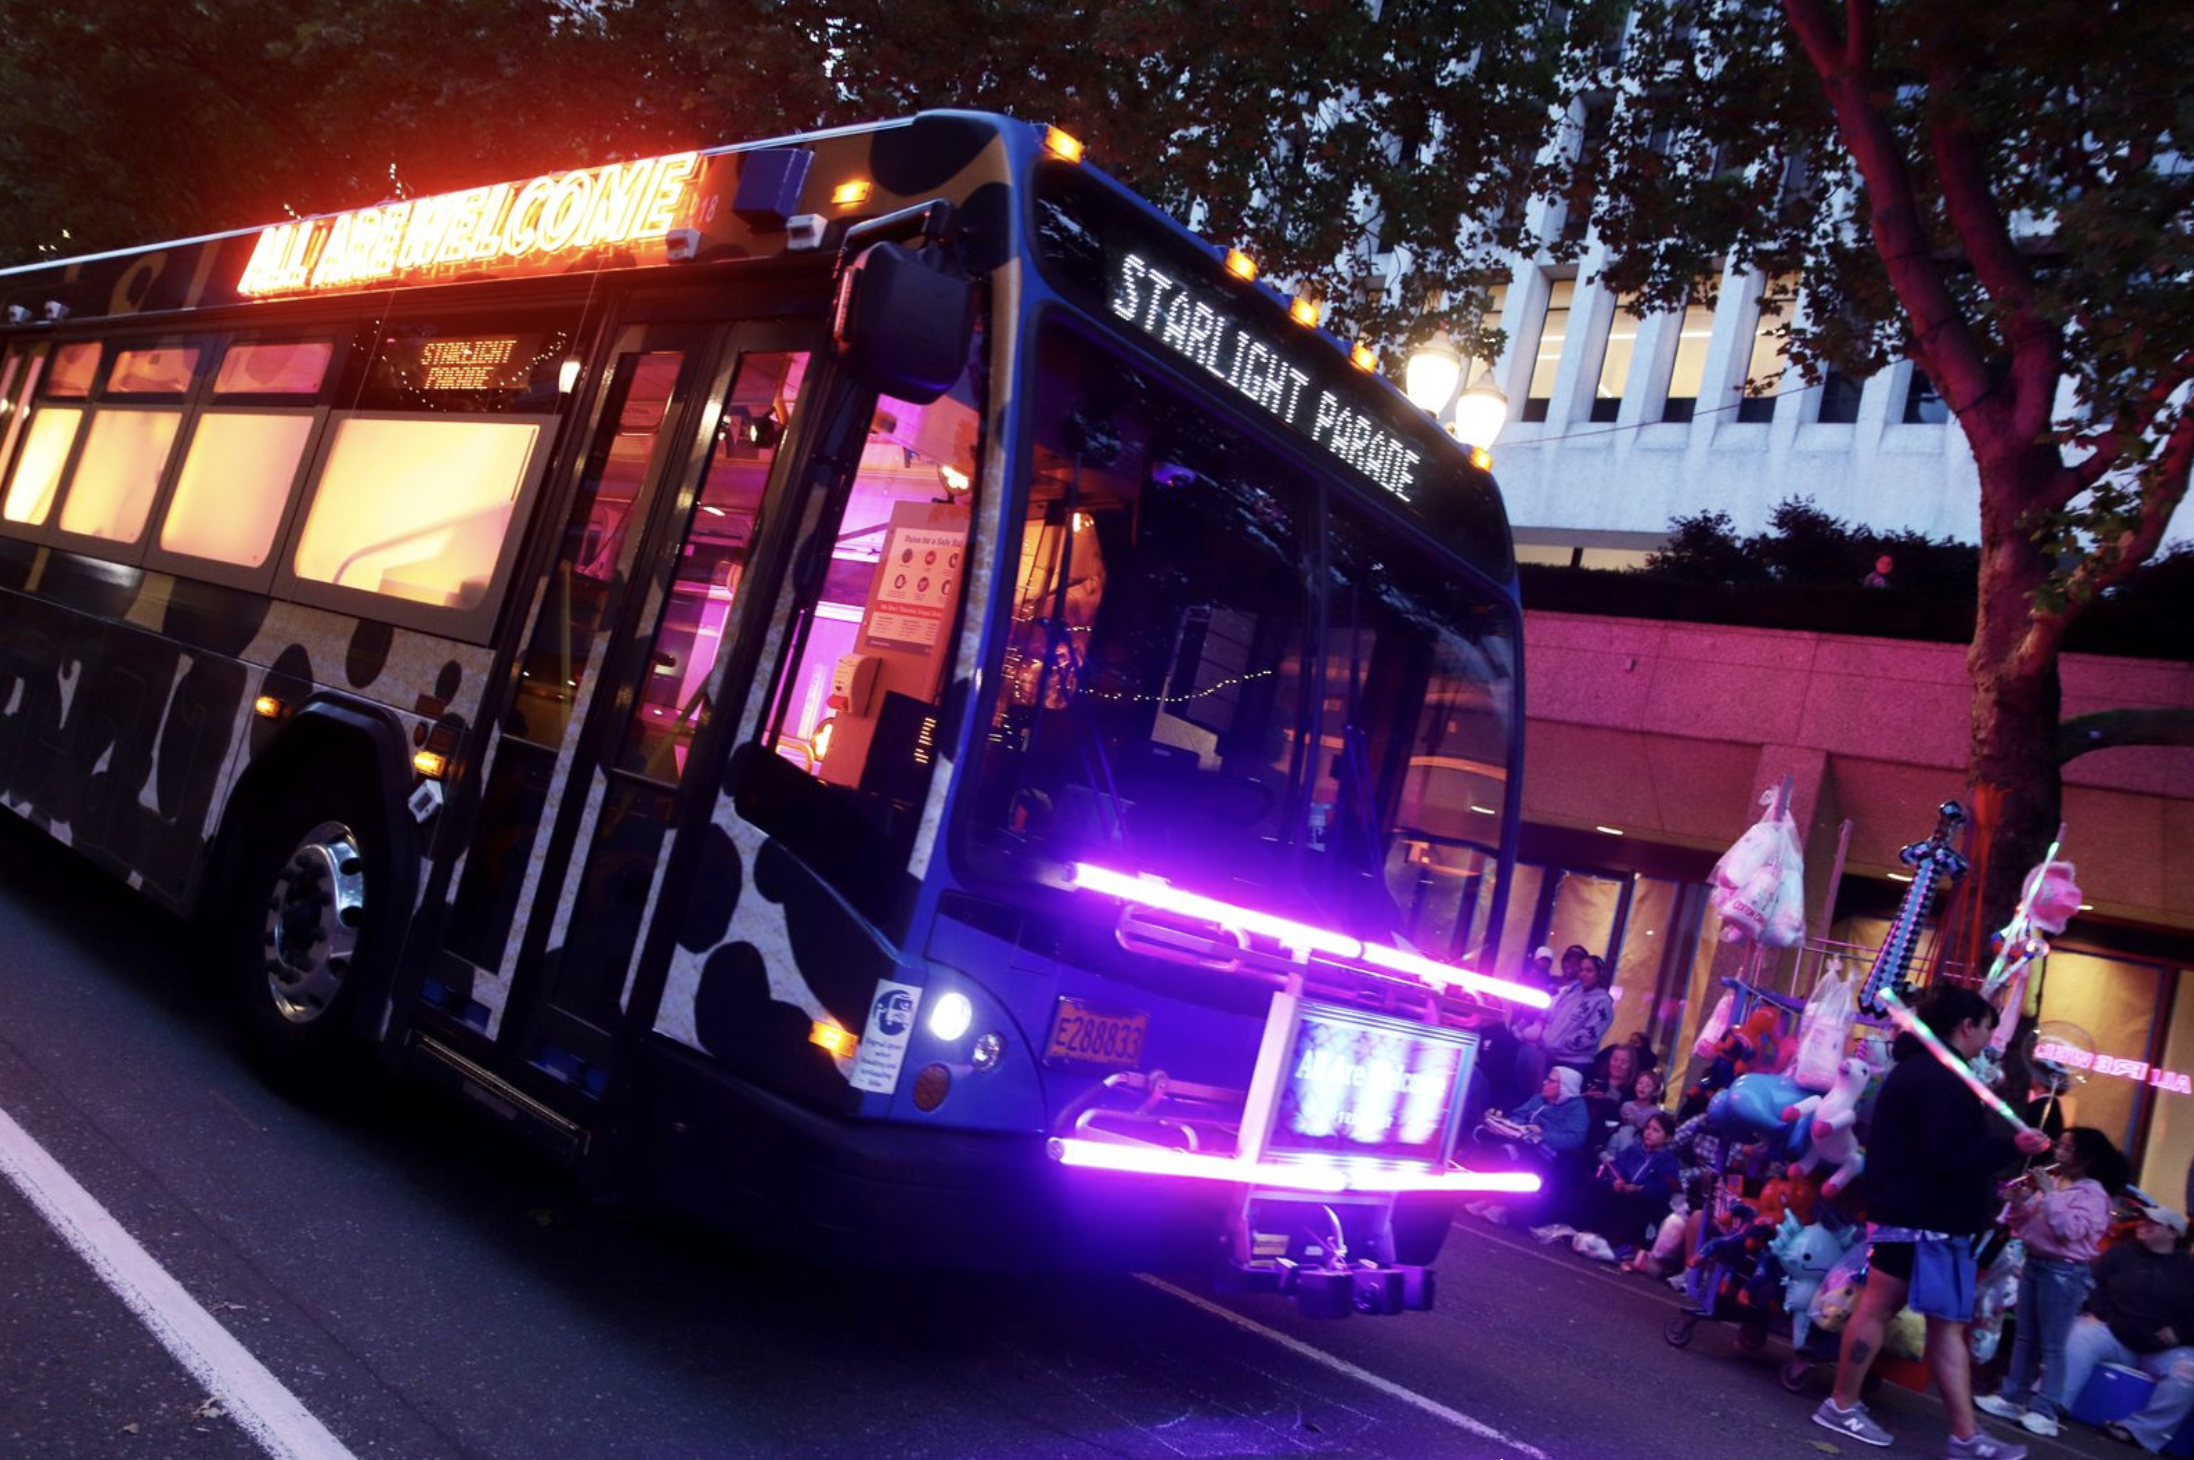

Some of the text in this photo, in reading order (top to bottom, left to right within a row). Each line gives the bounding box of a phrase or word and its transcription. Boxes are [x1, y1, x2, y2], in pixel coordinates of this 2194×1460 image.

[237, 150, 700, 297] ALL ARE WELCOME
[421, 340, 517, 365] STARLIGHT
[424, 367, 494, 389] PARADE
[1113, 254, 1420, 502] STARLIGHT PARADE
[1055, 1016, 1143, 1060] E288833
